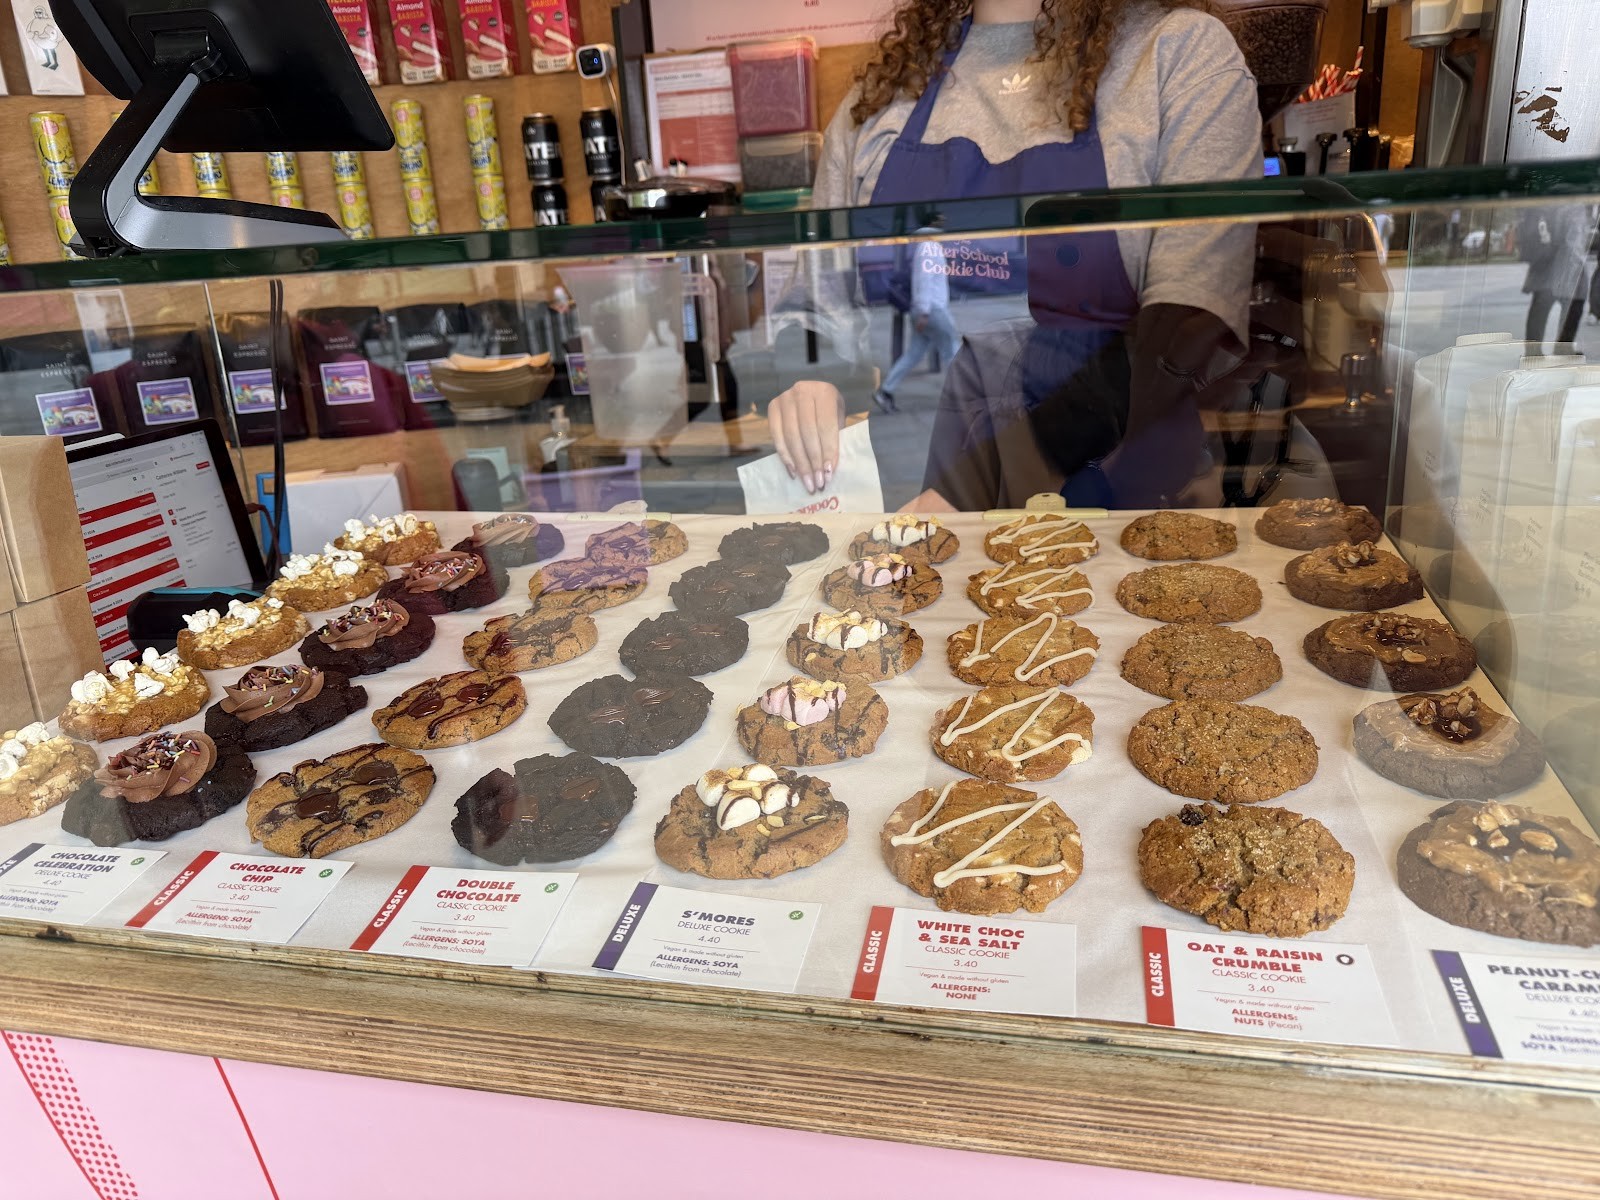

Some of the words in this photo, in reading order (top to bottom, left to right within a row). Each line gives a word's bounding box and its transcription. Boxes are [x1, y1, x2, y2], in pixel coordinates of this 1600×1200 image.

[396, 2, 424, 11] Almond
[920, 244, 959, 259] After
[960, 245, 1009, 266] School
[921, 258, 973, 277] Cookie
[975, 263, 1011, 280] Club
[51, 852, 121, 863] CHOCOLATE
[34, 860, 115, 873] CELEBRATION
[229, 862, 306, 875] CHOCOLATE
[35, 869, 62, 877] DELUXE
[62, 871, 92, 879] COOKIE
[241, 874, 274, 883] CHIP
[153, 870, 194, 906] CLASSIC
[217, 882, 249, 891] CLASSIC
[249, 884, 282, 894] COOKIE
[456, 878, 515, 890] DOUBLE
[436, 889, 521, 903] CHOCOLATE
[373, 888, 408, 928] CLASSIC
[436, 901, 471, 910] CLASSIC
[473, 903, 508, 912] COOKIE
[185, 912, 229, 921] ALLERGENS:
[454, 914, 475, 922] 3.40
[612, 903, 642, 943] DELUXE
[681, 909, 755, 926] S'MORES
[677, 920, 711, 932] DELUXE
[713, 925, 751, 936] COOKIE
[917, 919, 971, 934] WHITE
[977, 926, 1025, 939] CHOC
[410, 933, 459, 944] ALLERGENS:
[461, 938, 485, 946] SOYA
[431, 942, 448, 951] from
[698, 935, 720, 944] 4.40
[918, 933, 932, 942] &
[939, 935, 971, 946] SEA
[978, 938, 1020, 950] SALT
[663, 945, 681, 953] Vegan
[862, 930, 883, 974] CLASSIC
[924, 945, 965, 956] CLASSIC
[968, 949, 1010, 959] COOKIE
[1187, 942, 1226, 954] OAT
[1233, 946, 1249, 956] &
[1255, 947, 1323, 962] RAISIN
[656, 953, 710, 966] ALLERGENS:
[713, 960, 739, 969] SOYA
[953, 959, 978, 968] 3.40
[1211, 957, 1303, 973] CRUMBLE
[649, 960, 681, 971] (Lecithin
[683, 963, 700, 973] from
[702, 967, 742, 978] chocolate)
[1149, 952, 1165, 997] CLASSIC
[1211, 968, 1258, 980] CLASSIC
[1260, 973, 1307, 984] COOKIE
[919, 971, 939, 980] Vegan
[989, 977, 1010, 985] gluten
[930, 982, 991, 994] ALLERGENS:
[1247, 983, 1275, 994] 3.40
[1518, 980, 1600, 994] CARAM
[945, 991, 977, 1001] NONE
[1448, 976, 1481, 1024] DELUXE
[1231, 1008, 1298, 1021] ALLERGENS:
[1234, 1017, 1264, 1026] NUTS
[1267, 1020, 1303, 1031] (Pecan)
